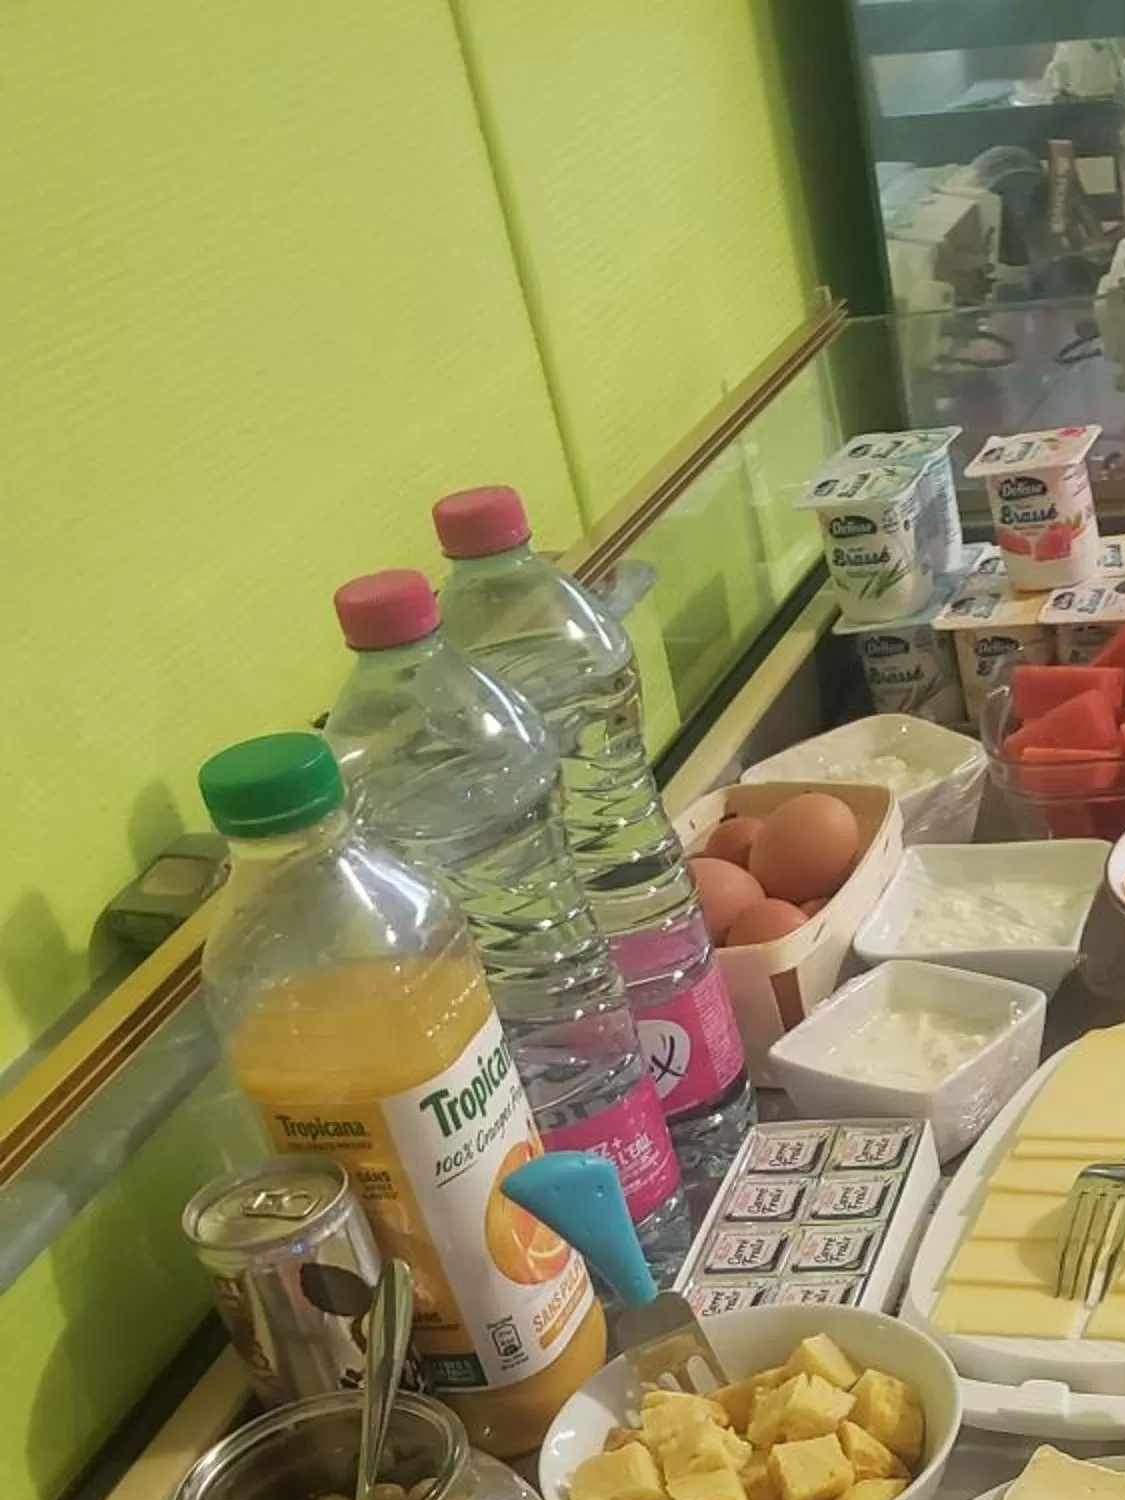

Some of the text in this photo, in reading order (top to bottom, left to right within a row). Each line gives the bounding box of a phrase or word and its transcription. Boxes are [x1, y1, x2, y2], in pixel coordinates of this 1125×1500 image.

[420, 1035, 512, 1138] Tropican
[274, 1114, 368, 1140] Tropicana
[434, 1139, 474, 1177] 100%
